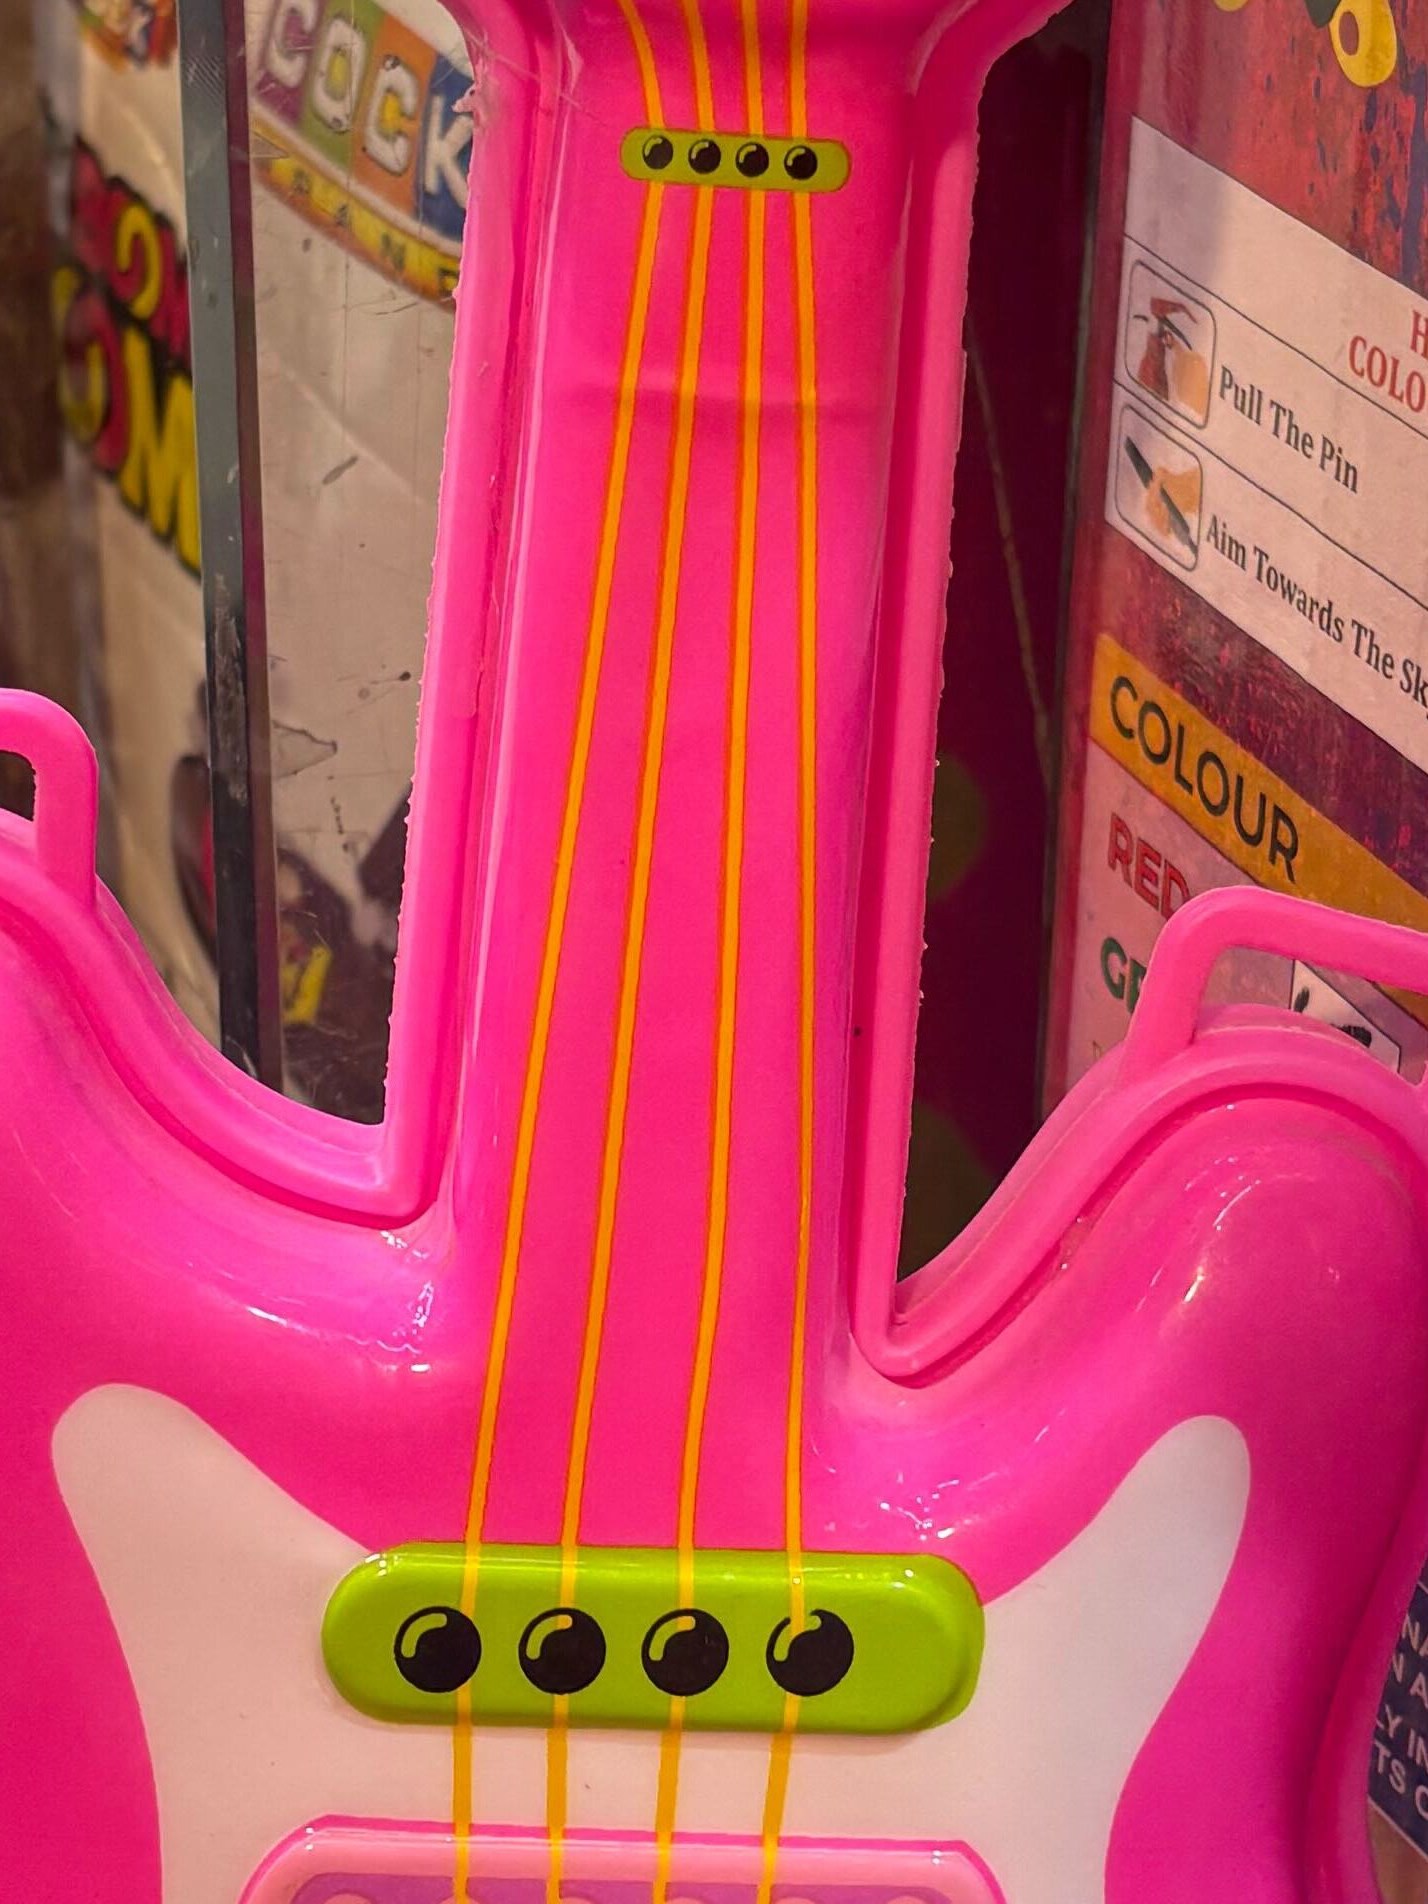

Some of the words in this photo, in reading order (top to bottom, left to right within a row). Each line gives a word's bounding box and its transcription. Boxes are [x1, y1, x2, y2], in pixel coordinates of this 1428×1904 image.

[289, 166, 461, 297] RAND
[1218, 366, 1264, 428] Pull
[1268, 397, 1315, 465] The
[1320, 431, 1360, 495] Pin
[1205, 514, 1248, 576] Aim
[1251, 545, 1346, 643] Towards
[1350, 609, 1395, 671] The
[1109, 674, 1301, 885] COLOUR
[1108, 813, 1191, 921] RED
